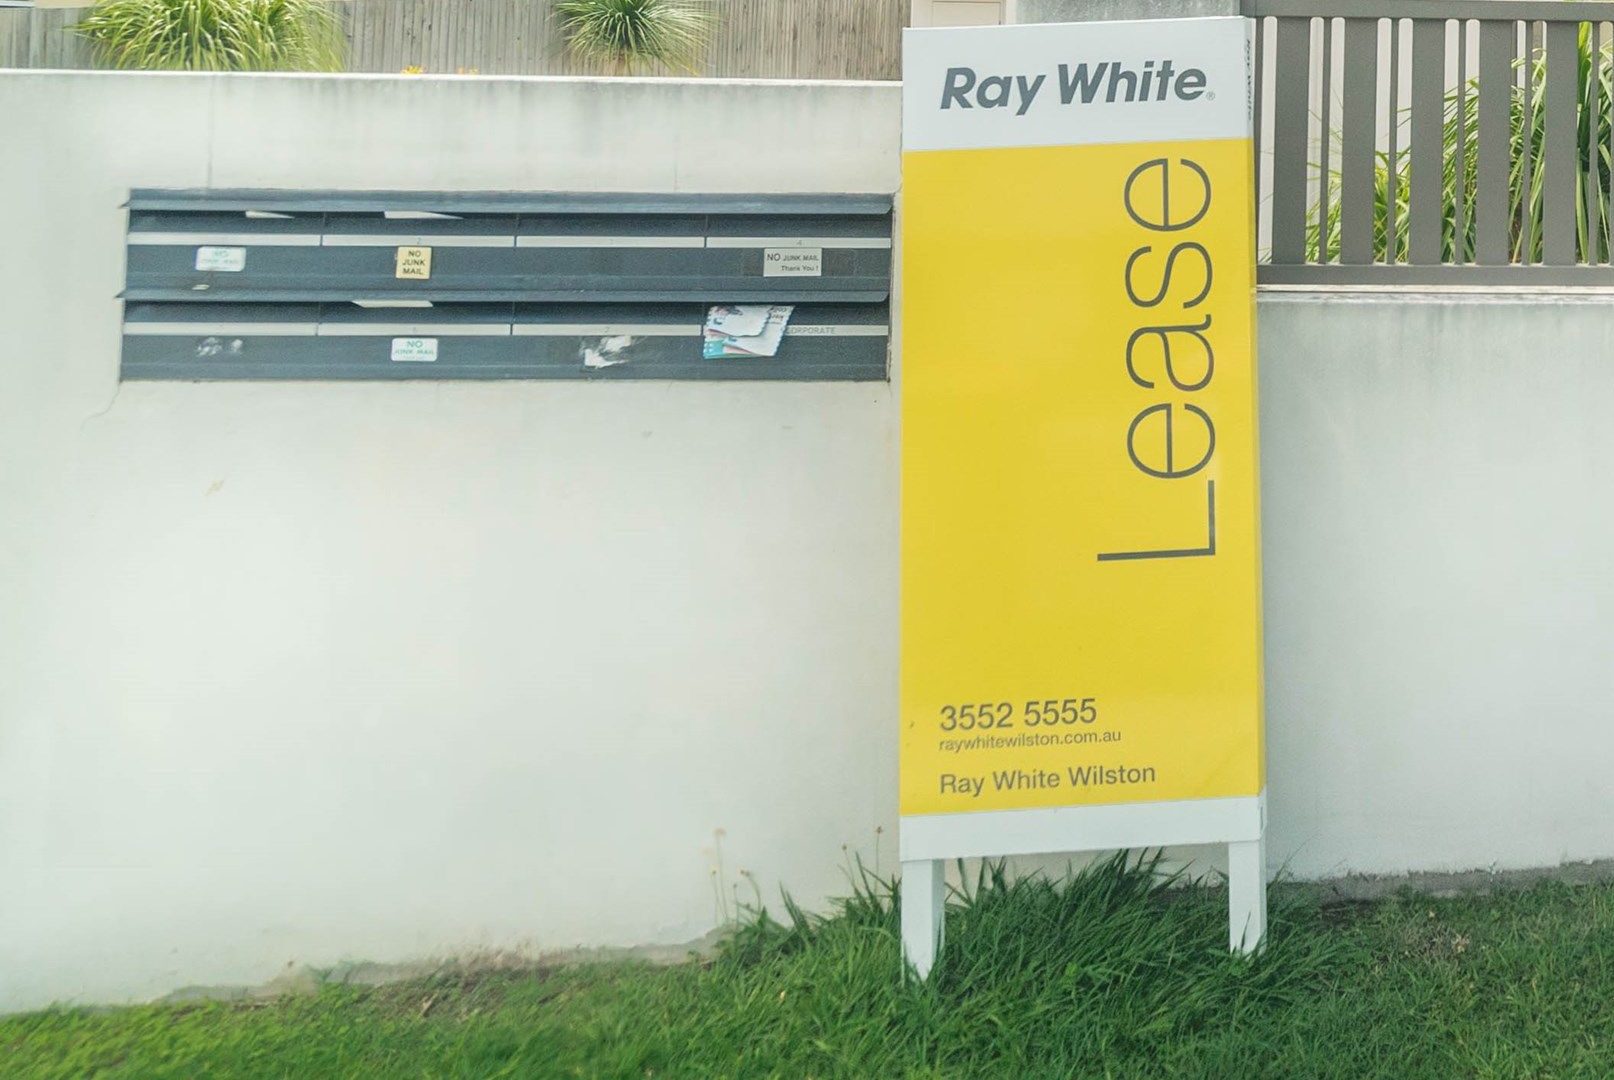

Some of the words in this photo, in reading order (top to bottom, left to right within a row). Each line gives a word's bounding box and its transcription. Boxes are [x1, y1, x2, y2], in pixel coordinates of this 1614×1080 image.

[940, 67, 1045, 116] Ray
[1057, 60, 1208, 105] White
[408, 250, 422, 258] NO
[766, 253, 781, 262] NO
[402, 259, 426, 267] JUNK
[402, 267, 425, 276] MAIL
[406, 340, 424, 349] NO
[1097, 157, 1216, 561] Lease
[939, 702, 1014, 732] 3552
[1024, 698, 1097, 727] 5555
[939, 729, 1121, 753] raywhitewilston.com.au
[939, 774, 985, 797] Ray
[993, 768, 1060, 792] White
[1068, 763, 1156, 788] Wilston
